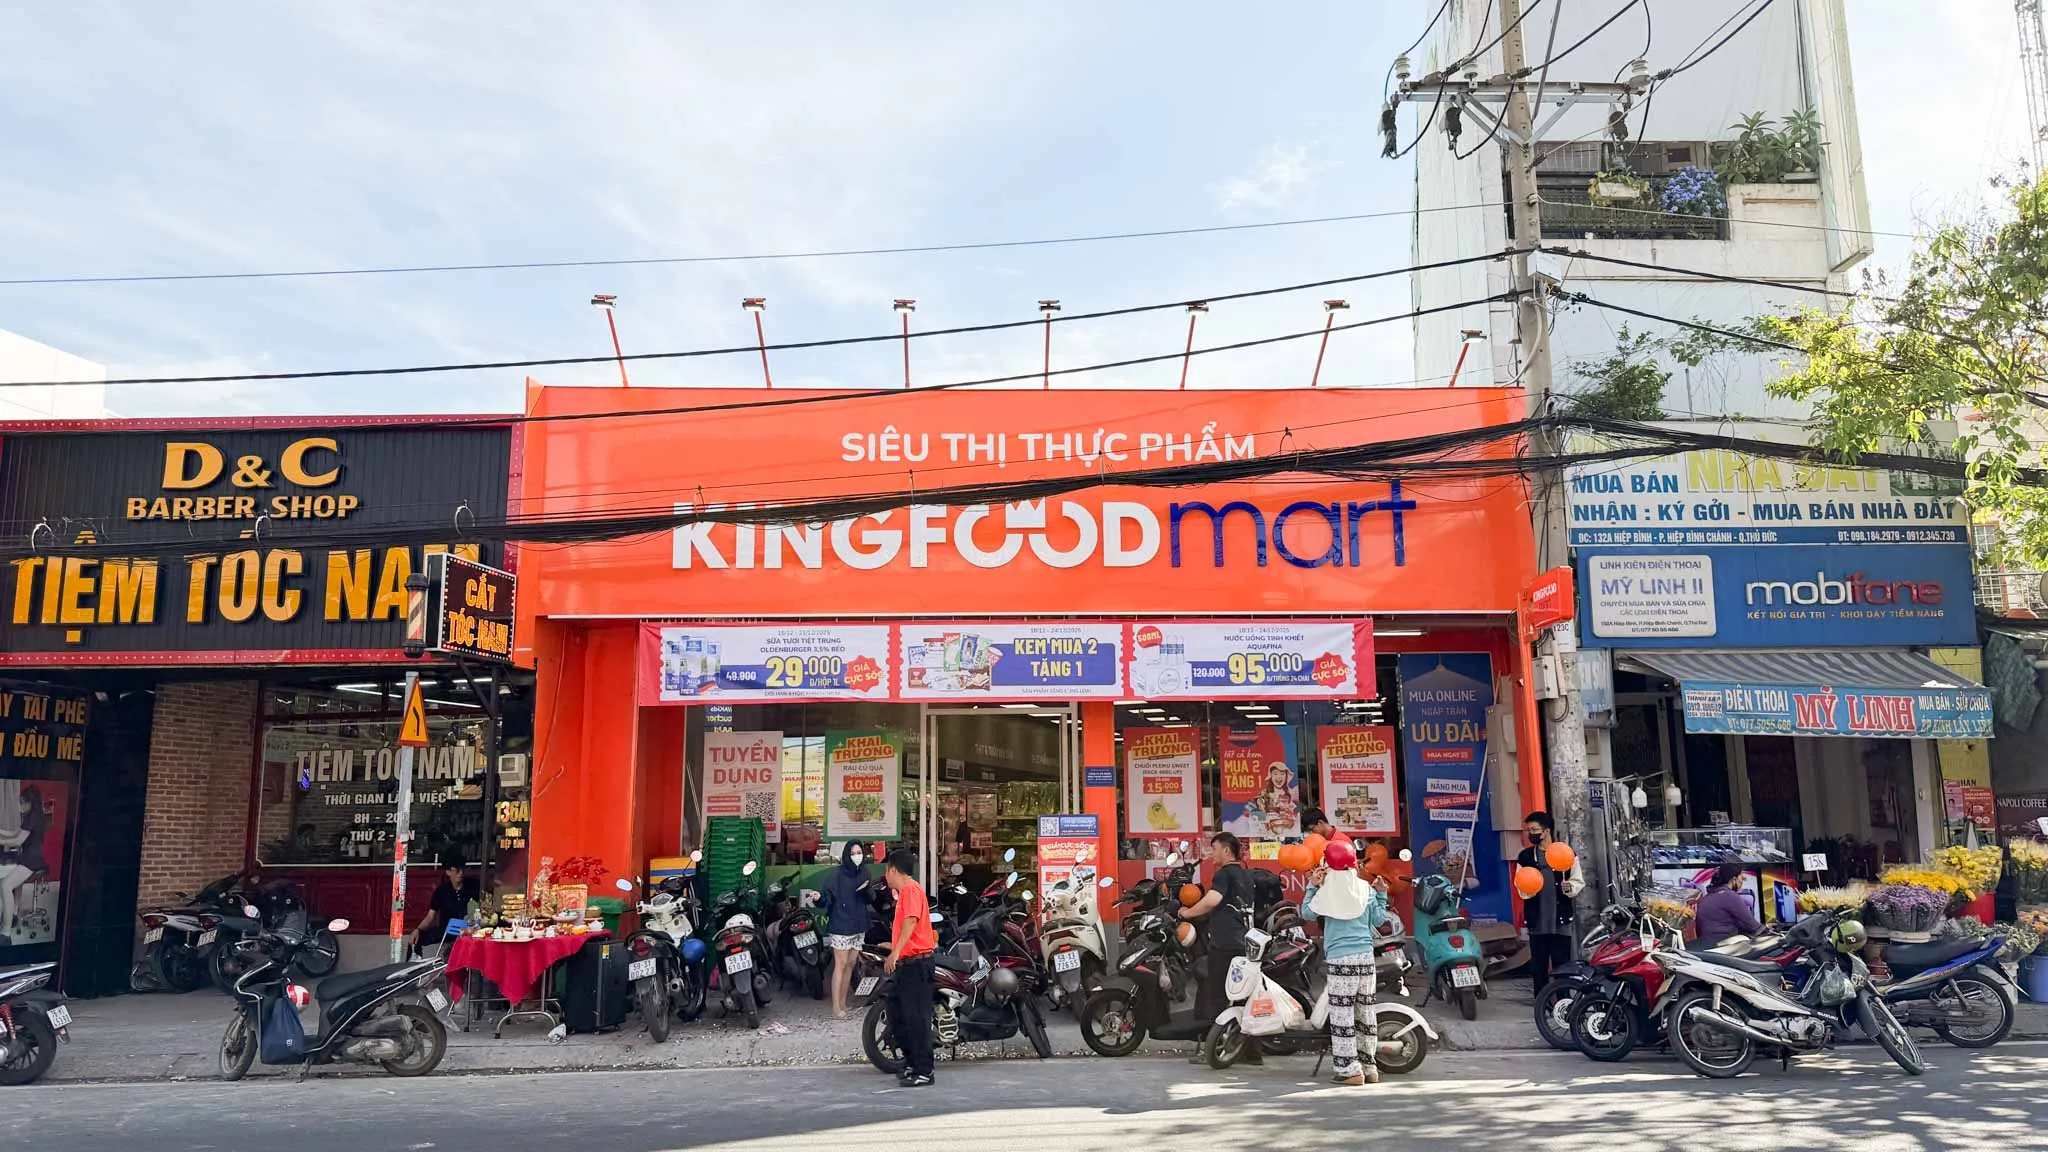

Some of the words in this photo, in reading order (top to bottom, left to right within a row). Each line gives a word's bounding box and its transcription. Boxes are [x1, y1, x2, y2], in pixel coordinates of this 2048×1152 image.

[841, 425, 929, 462] SIÊU
[940, 432, 1006, 468] THỊ
[1018, 428, 1128, 468] THỰC
[1140, 420, 1255, 462] PHẨM
[1573, 474, 1624, 493] MUA
[1631, 471, 1679, 493] BÁN
[127, 496, 254, 521] BARBER
[269, 495, 358, 519] SHOP
[1573, 500, 1637, 526] NHẬN
[1659, 500, 1686, 520] KÝ
[1753, 503, 1802, 520] MUA
[1809, 499, 1854, 520] BÁN
[1862, 498, 1908, 520] NHÀ
[1914, 495, 1954, 520] ĐẤT
[1593, 532, 1613, 543] 132A
[1614, 530, 1632, 545] HIỆP
[1633, 530, 1651, 543] BÌNH
[1667, 530, 1685, 545] HIỆP
[1686, 530, 1704, 543] BÌNH
[1706, 530, 1732, 543] CHÁNH
[1762, 529, 1778, 543] ĐỨC
[10, 530, 159, 643] TIỆM
[183, 529, 304, 623] TÓC
[324, 543, 481, 621] NA
[466, 573, 496, 613] CẮT
[1640, 578, 1686, 594] LINH
[1746, 571, 1944, 605] mobifone
[449, 609, 476, 645] TÓC
[477, 618, 509, 655] NAM
[1014, 638, 1047, 655] KEM
[1050, 638, 1084, 655] MUA
[1087, 638, 1098, 655] 2
[853, 661, 870, 673] GIÁ
[1031, 658, 1071, 682] TẶNG
[1075, 661, 1083, 677] 1
[1320, 658, 1336, 669] GIÁ
[1409, 690, 1434, 702] MUA
[1436, 690, 1477, 702] ONLINE
[1918, 695, 1934, 711] MUA
[1935, 692, 1951, 710] BÁN
[1845, 695, 1916, 731] LINH
[1145, 734, 1177, 746] KHAI
[1339, 732, 1372, 745] KHAI
[1411, 720, 1440, 743] ƯU
[1445, 719, 1480, 743] ĐÃI
[709, 739, 778, 763] TUYỂN
[847, 736, 880, 748] KHAI
[295, 742, 354, 790] TIỆM
[418, 746, 475, 780] NAM
[1224, 760, 1249, 773] MUA
[1252, 760, 1260, 773] 2
[714, 767, 773, 789] DỤNG
[1224, 772, 1255, 791] TẶNG
[1258, 775, 1262, 788] 1
[324, 791, 351, 805] THỜI
[354, 793, 384, 805] GIAN
[420, 790, 447, 808] VIỆC
[1997, 798, 2020, 808] NAPOLI
[2021, 798, 2047, 808] COFFEE
[354, 813, 370, 824] 8H
[495, 800, 529, 823] 136A
[350, 829, 374, 842] THỨ
[377, 830, 386, 841] 2
[1807, 854, 1825, 868] 15K
